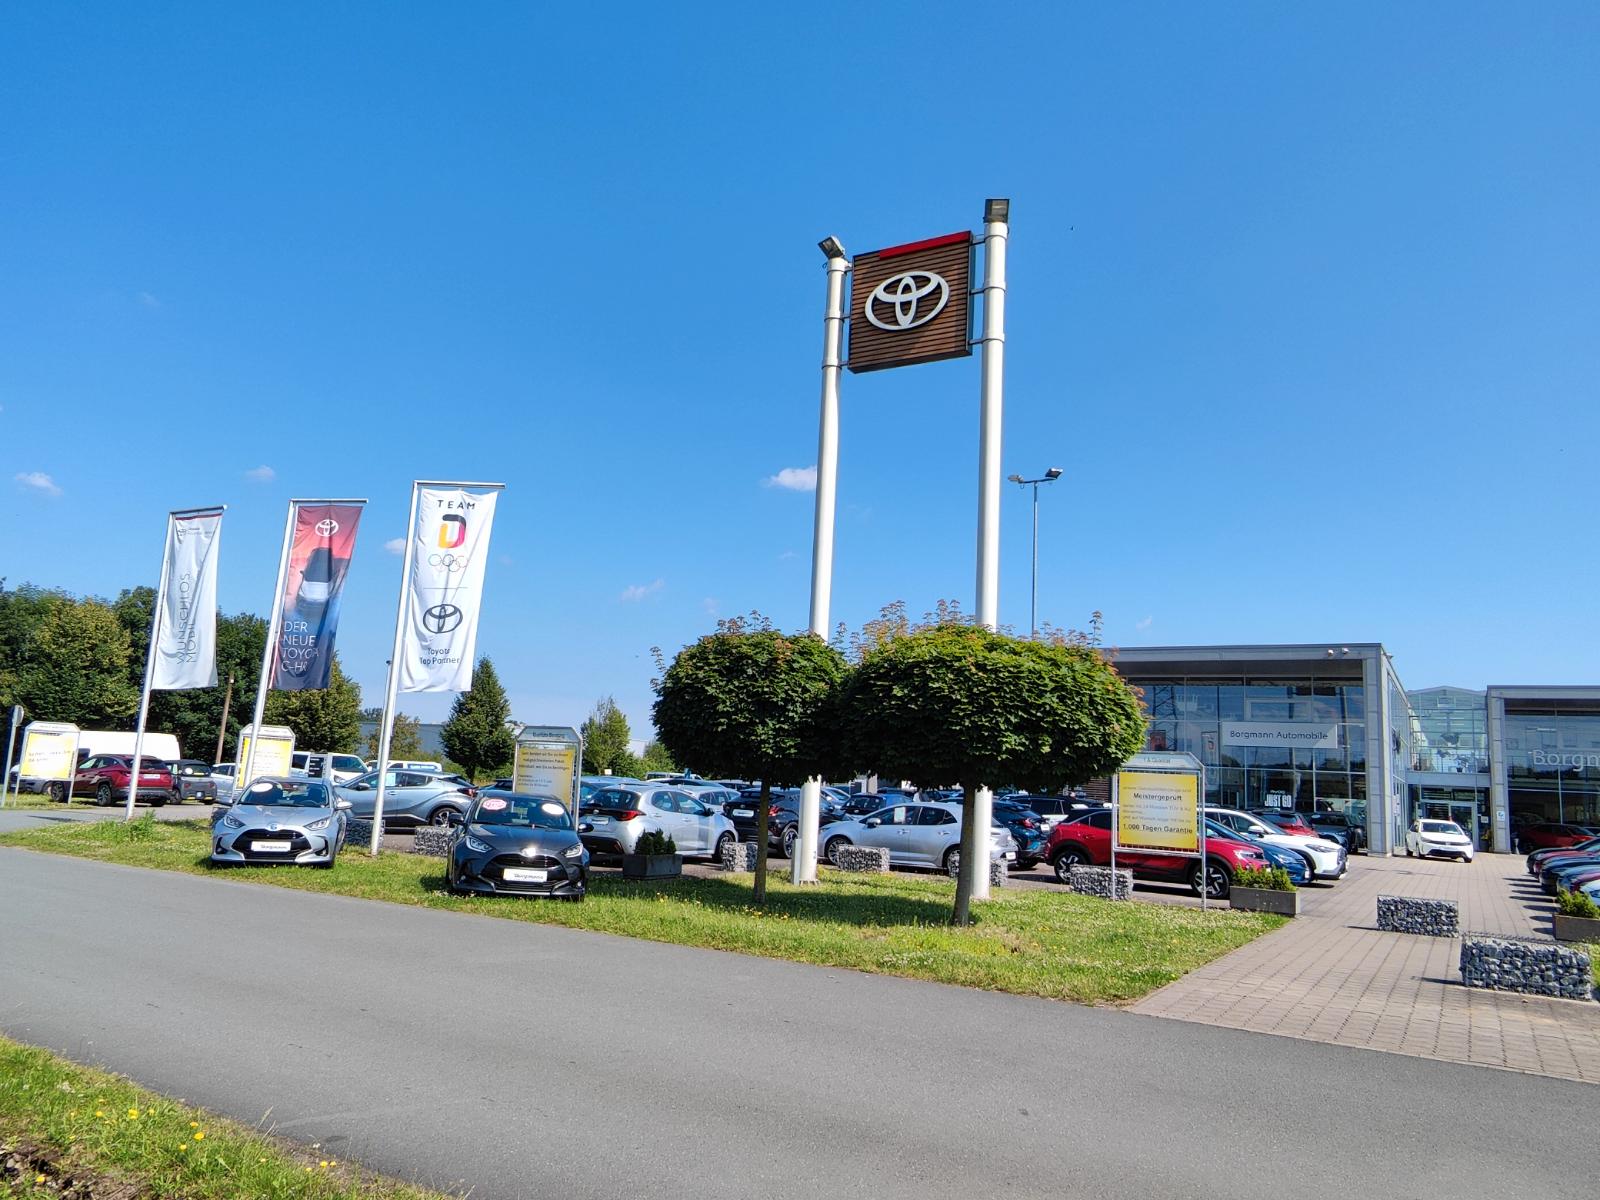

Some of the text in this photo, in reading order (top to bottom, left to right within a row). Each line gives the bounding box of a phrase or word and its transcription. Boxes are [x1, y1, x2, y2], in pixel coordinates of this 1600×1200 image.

[438, 500, 475, 510] TEAM
[284, 621, 308, 632] DER
[283, 634, 317, 647] NEUE
[1230, 730, 1329, 740] Borgmann Automobile
